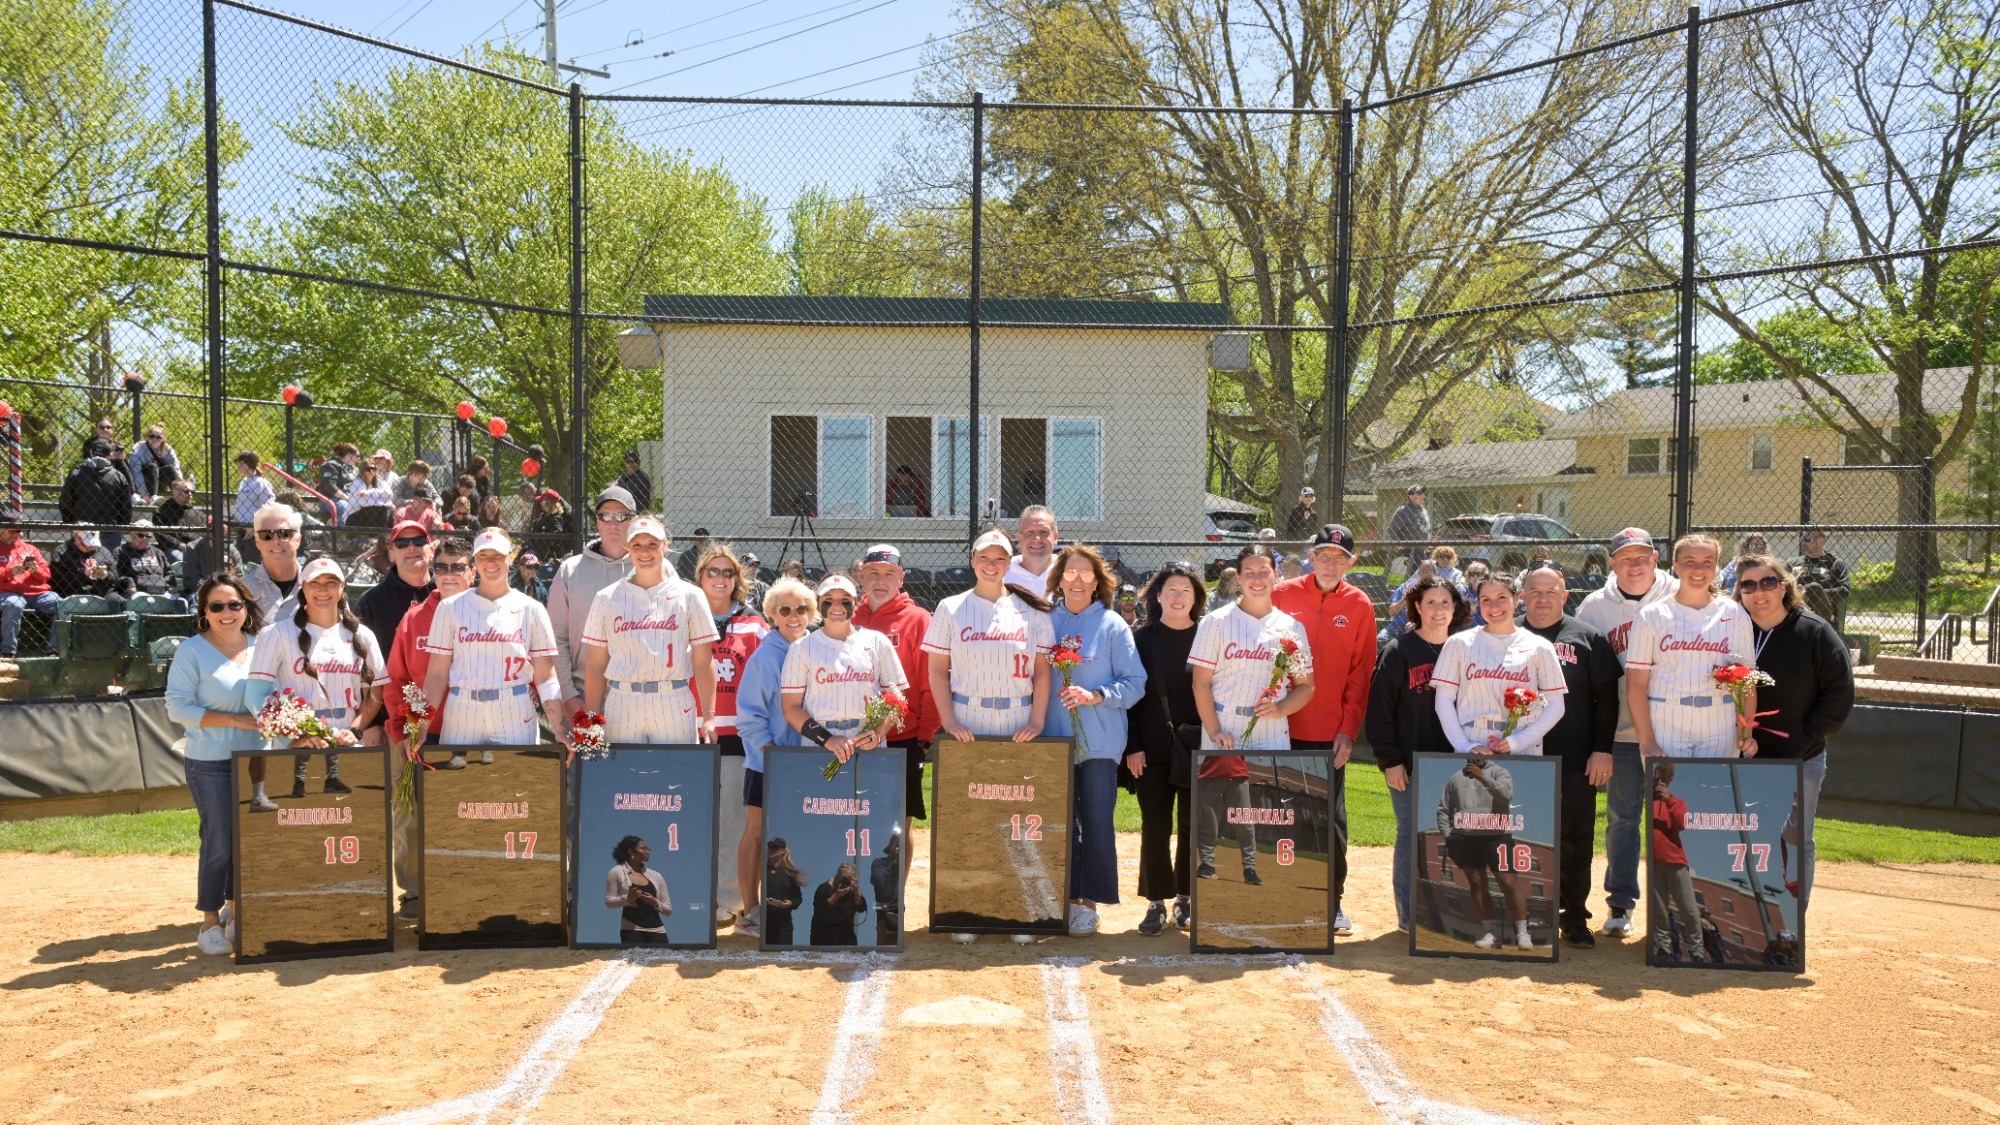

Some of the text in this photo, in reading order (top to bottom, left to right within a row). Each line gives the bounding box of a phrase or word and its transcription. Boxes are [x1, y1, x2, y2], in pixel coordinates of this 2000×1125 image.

[614, 614, 680, 634] Cardinals
[458, 626, 526, 644] Cardinals
[960, 626, 1028, 643] Cardinals
[1659, 633, 1731, 654] Cardinals
[666, 643, 674, 668] 1
[1224, 642, 1273, 661] Cardin
[504, 656, 526, 682] 17
[1013, 653, 1030, 679] 12
[1465, 663, 1531, 683] Cardinals
[968, 782, 1035, 802] CARDINALS
[457, 801, 529, 820] CARDINALS
[613, 793, 682, 812] CARDINALS
[803, 797, 870, 816] CARDINALS
[278, 806, 352, 825] CARDINALS
[1226, 807, 1295, 826] CARDINALS
[1453, 812, 1524, 831] CARDINALS
[1683, 812, 1759, 831] CARDINALS
[667, 823, 679, 851] 1
[1010, 814, 1043, 841] 12
[324, 835, 360, 865] 19
[504, 831, 538, 859] 17
[845, 828, 871, 856] 11
[1276, 838, 1295, 866] 6
[1496, 843, 1533, 872] 16
[1727, 843, 1771, 872] 77
